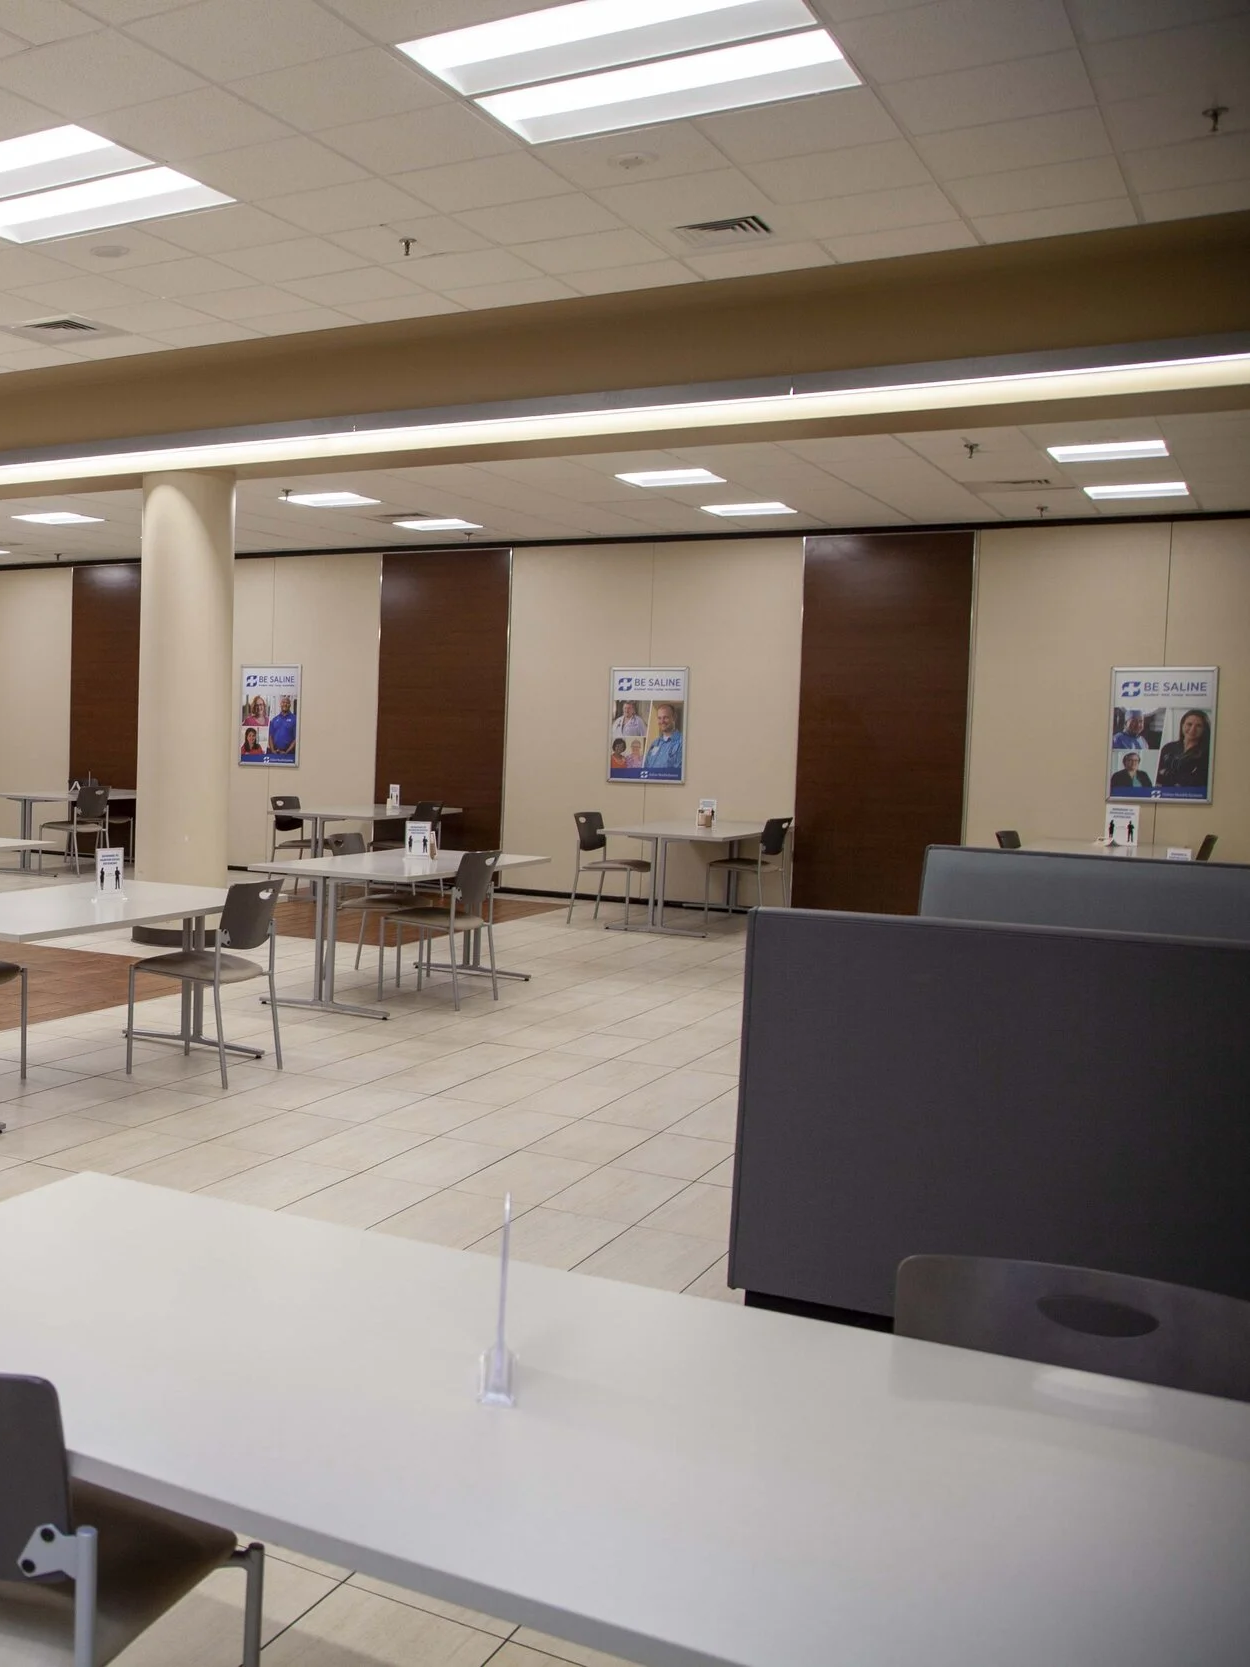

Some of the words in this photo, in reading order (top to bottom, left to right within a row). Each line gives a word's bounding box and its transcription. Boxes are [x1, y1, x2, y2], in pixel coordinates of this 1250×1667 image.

[258, 675, 268, 683] BE
[270, 675, 295, 683] SALINE
[634, 678, 646, 687] BE
[648, 678, 681, 687] SALINE
[1144, 682, 1159, 691] BE
[1163, 682, 1208, 692] SALINE
